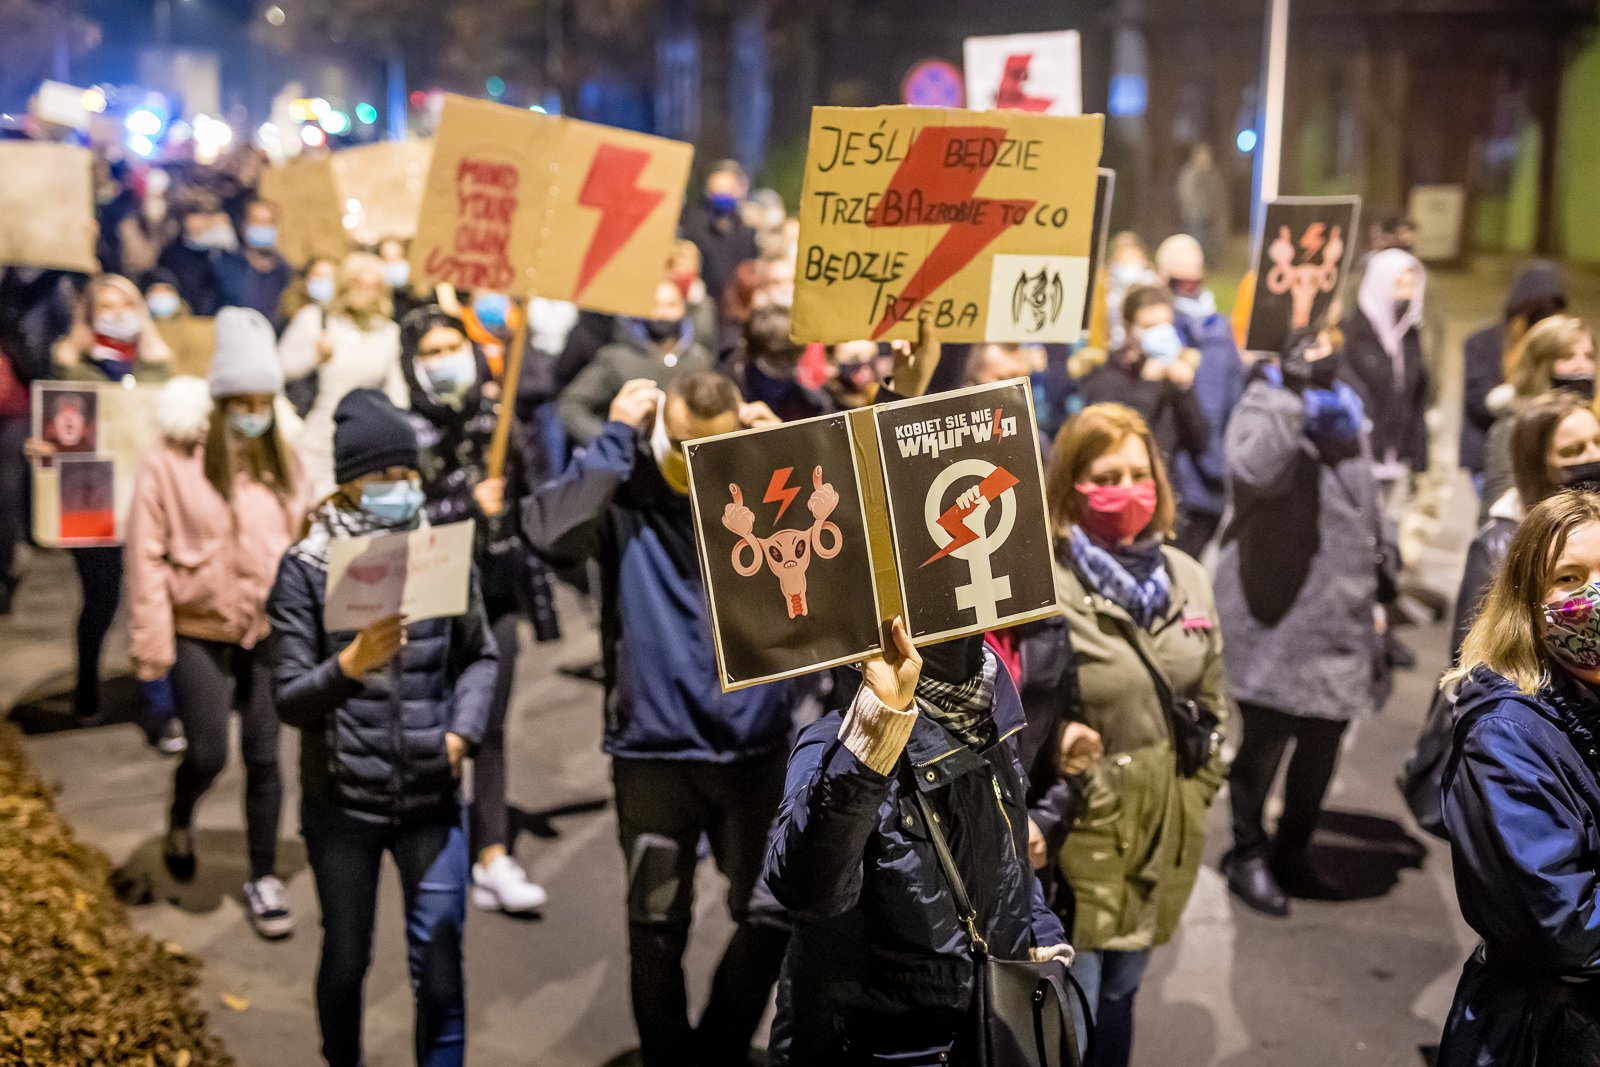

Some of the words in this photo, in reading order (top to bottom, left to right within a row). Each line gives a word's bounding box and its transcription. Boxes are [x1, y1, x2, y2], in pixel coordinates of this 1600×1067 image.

[817, 119, 917, 172] JEŚLI
[943, 137, 1043, 174] BĘDZIE
[814, 188, 923, 226] TRZEBA
[1001, 205, 1027, 225] TO
[1035, 204, 1068, 228] CO
[804, 245, 909, 286] BĘDZIE
[868, 278, 979, 328] TRZEBA
[894, 418, 942, 439] KOBIET
[945, 413, 967, 428] SIĘ
[970, 407, 993, 424] NIE
